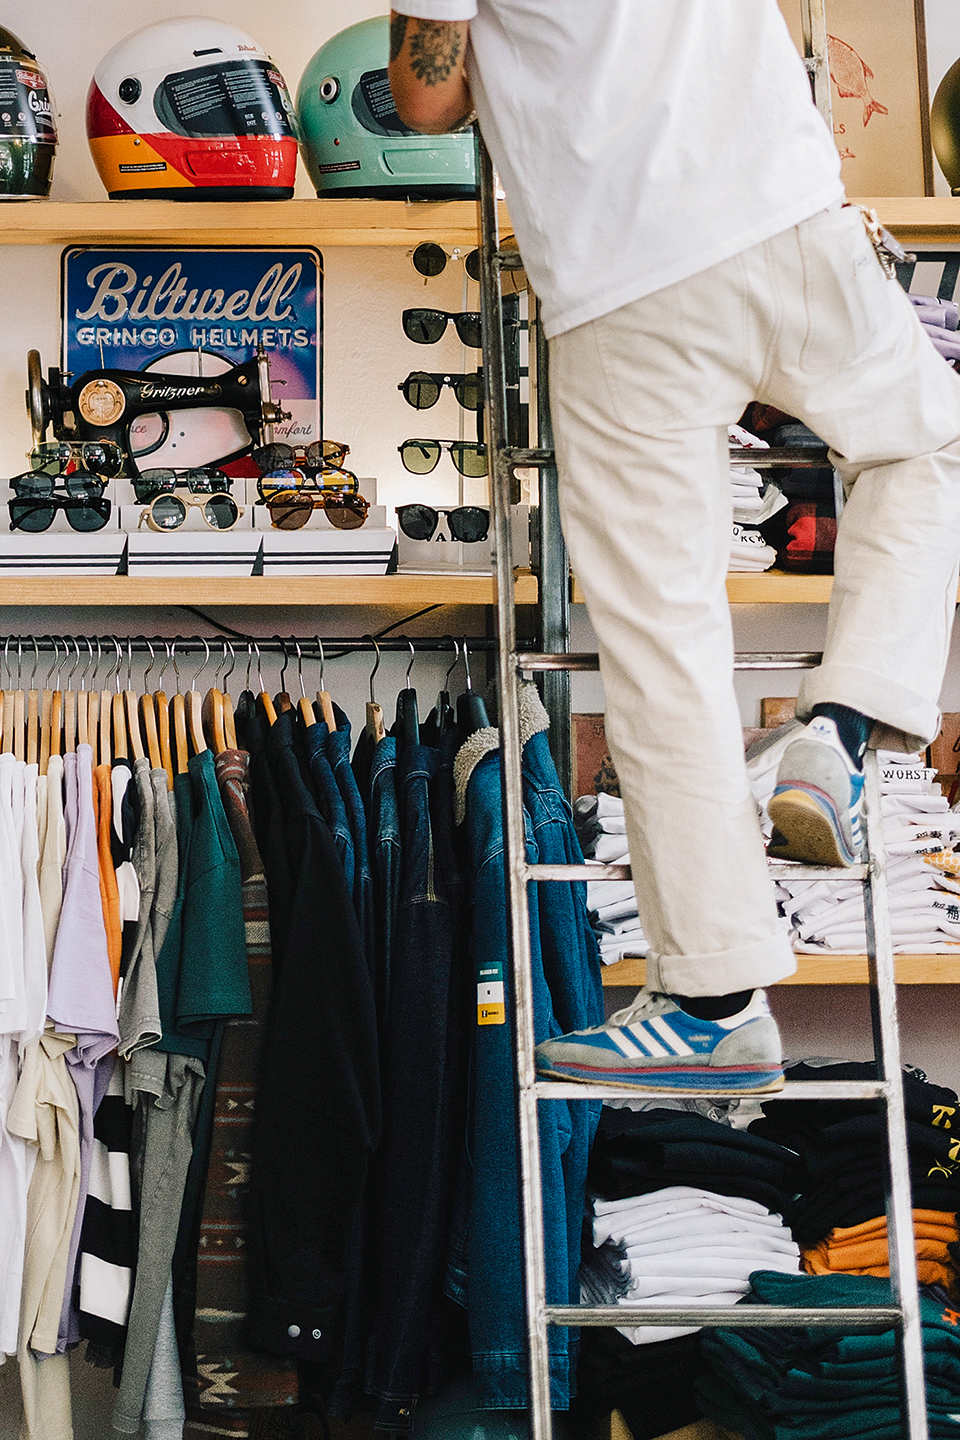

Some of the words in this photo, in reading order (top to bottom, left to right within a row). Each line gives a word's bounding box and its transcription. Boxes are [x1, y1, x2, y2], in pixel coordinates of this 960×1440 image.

[75, 262, 303, 322] Biltwell
[76, 327, 177, 347] GRINGO
[192, 328, 310, 347] HELMETS
[140, 383, 205, 402] Gritzner
[882, 769, 930, 781] WORST
